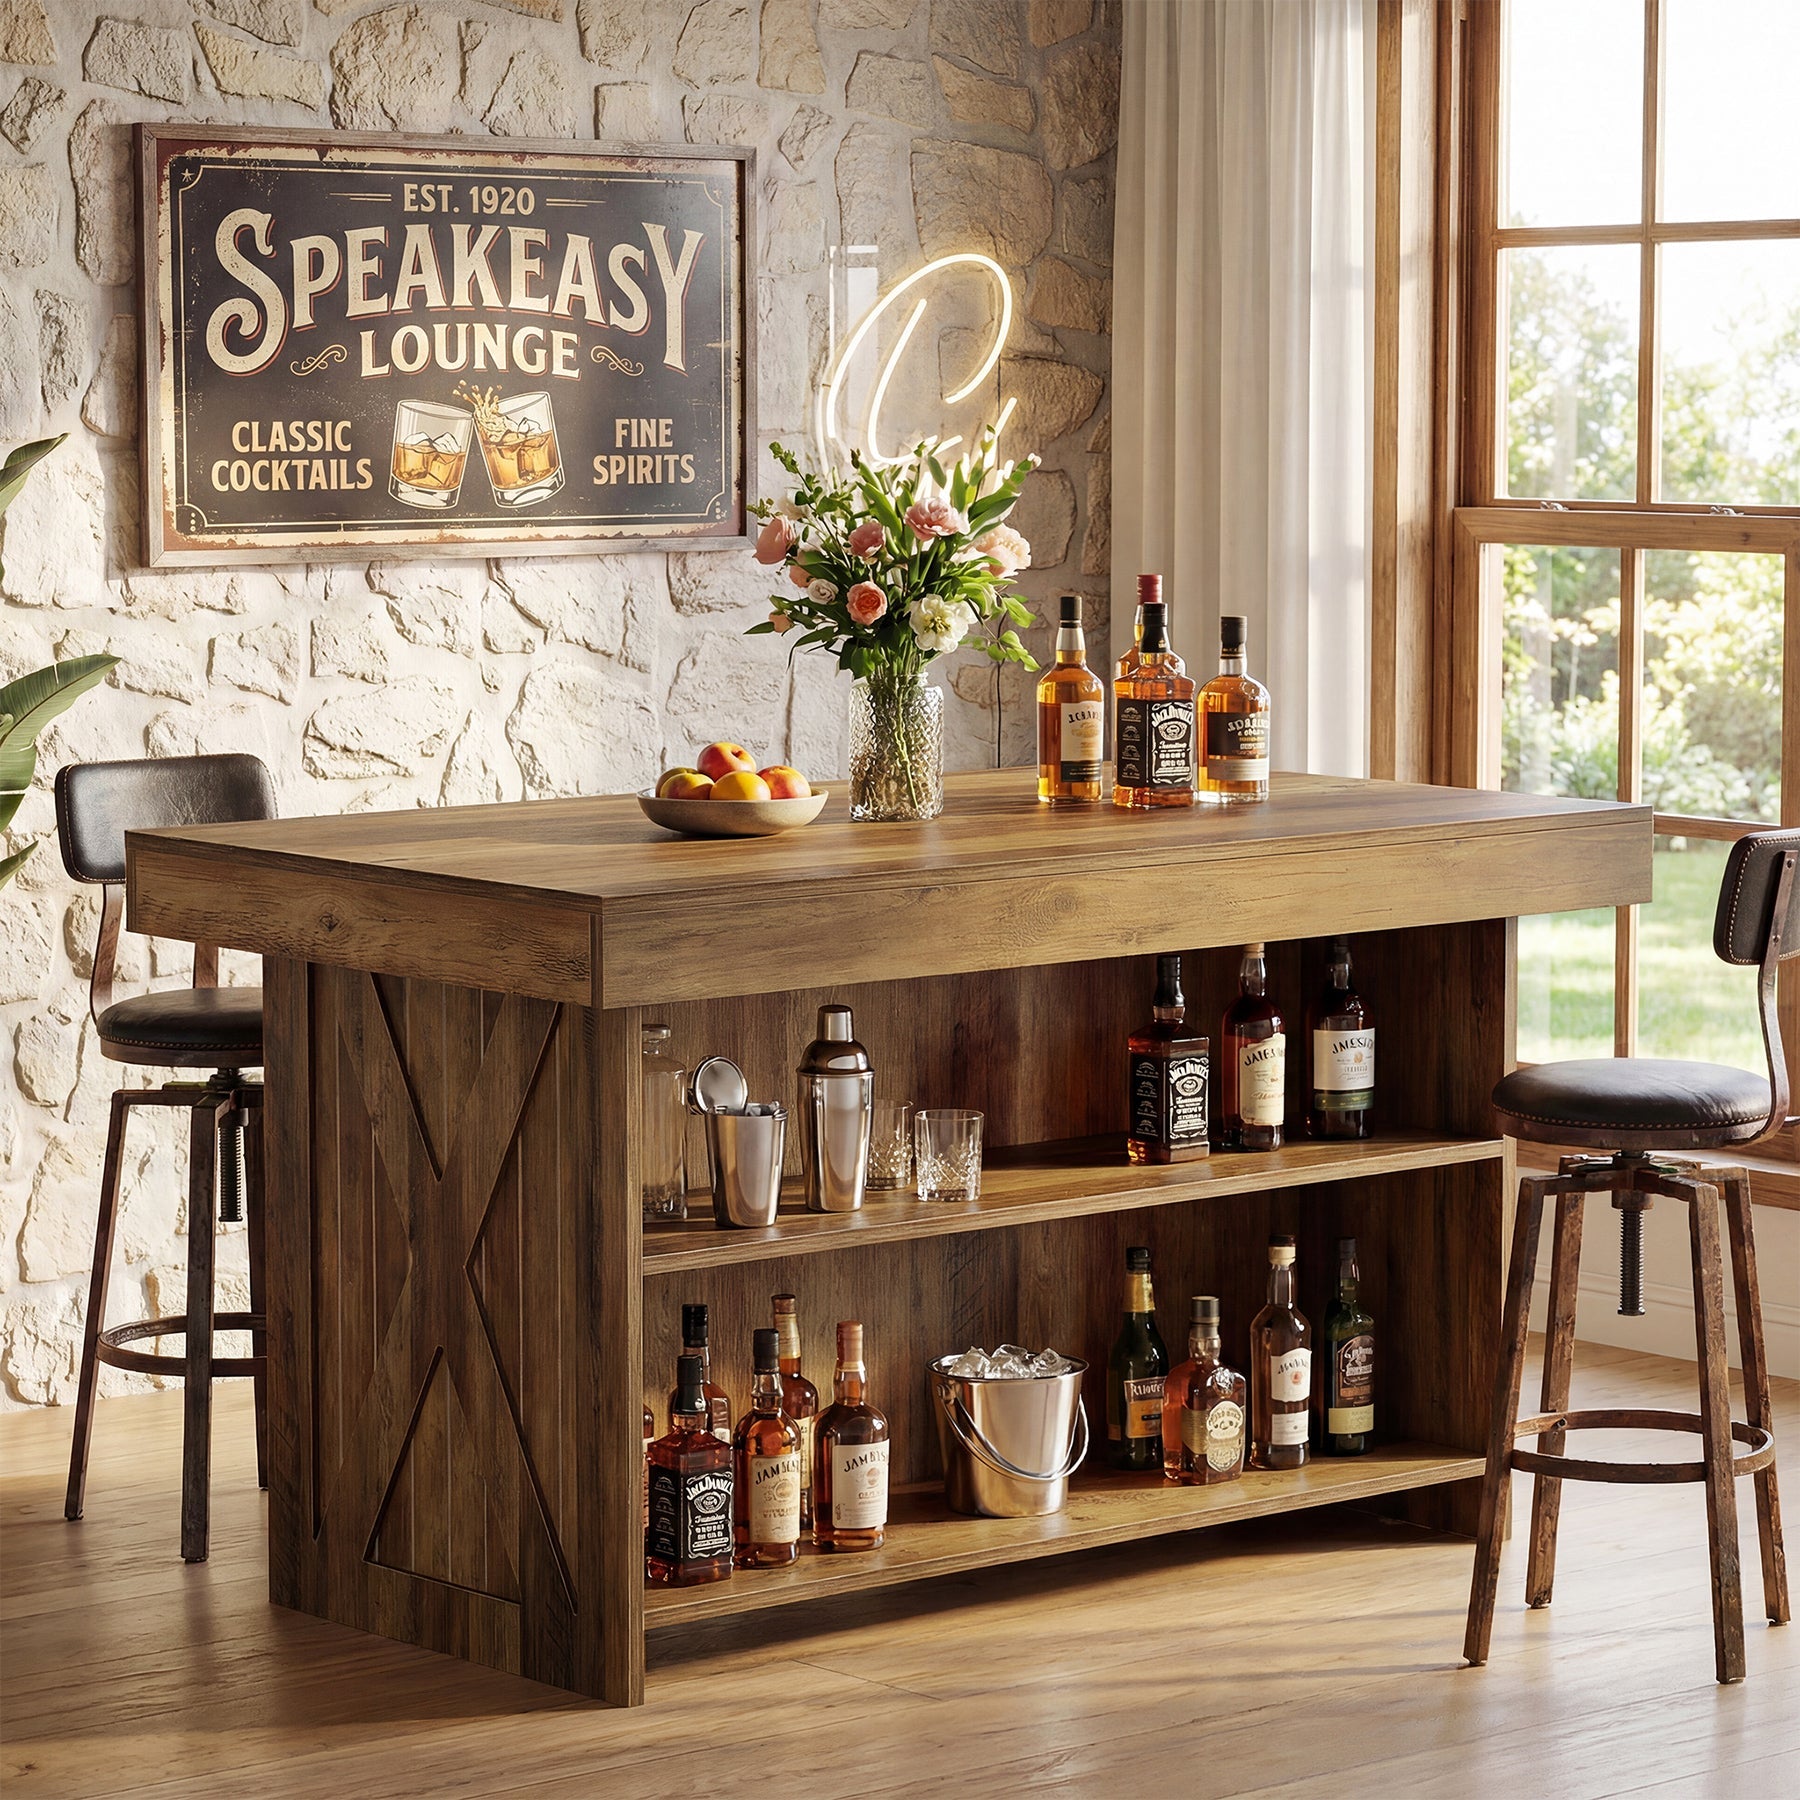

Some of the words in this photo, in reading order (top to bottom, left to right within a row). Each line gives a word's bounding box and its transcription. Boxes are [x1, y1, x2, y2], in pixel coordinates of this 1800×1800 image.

[403, 184, 460, 213] EST.
[470, 186, 535, 215] 1920
[206, 208, 705, 376] SPEAKEASY
[360, 323, 581, 379] LOUNGE
[232, 420, 352, 453] CLASSIC
[615, 418, 673, 449] FINE
[211, 457, 373, 493] COCKTAILS
[593, 453, 695, 486] SPIRITS
